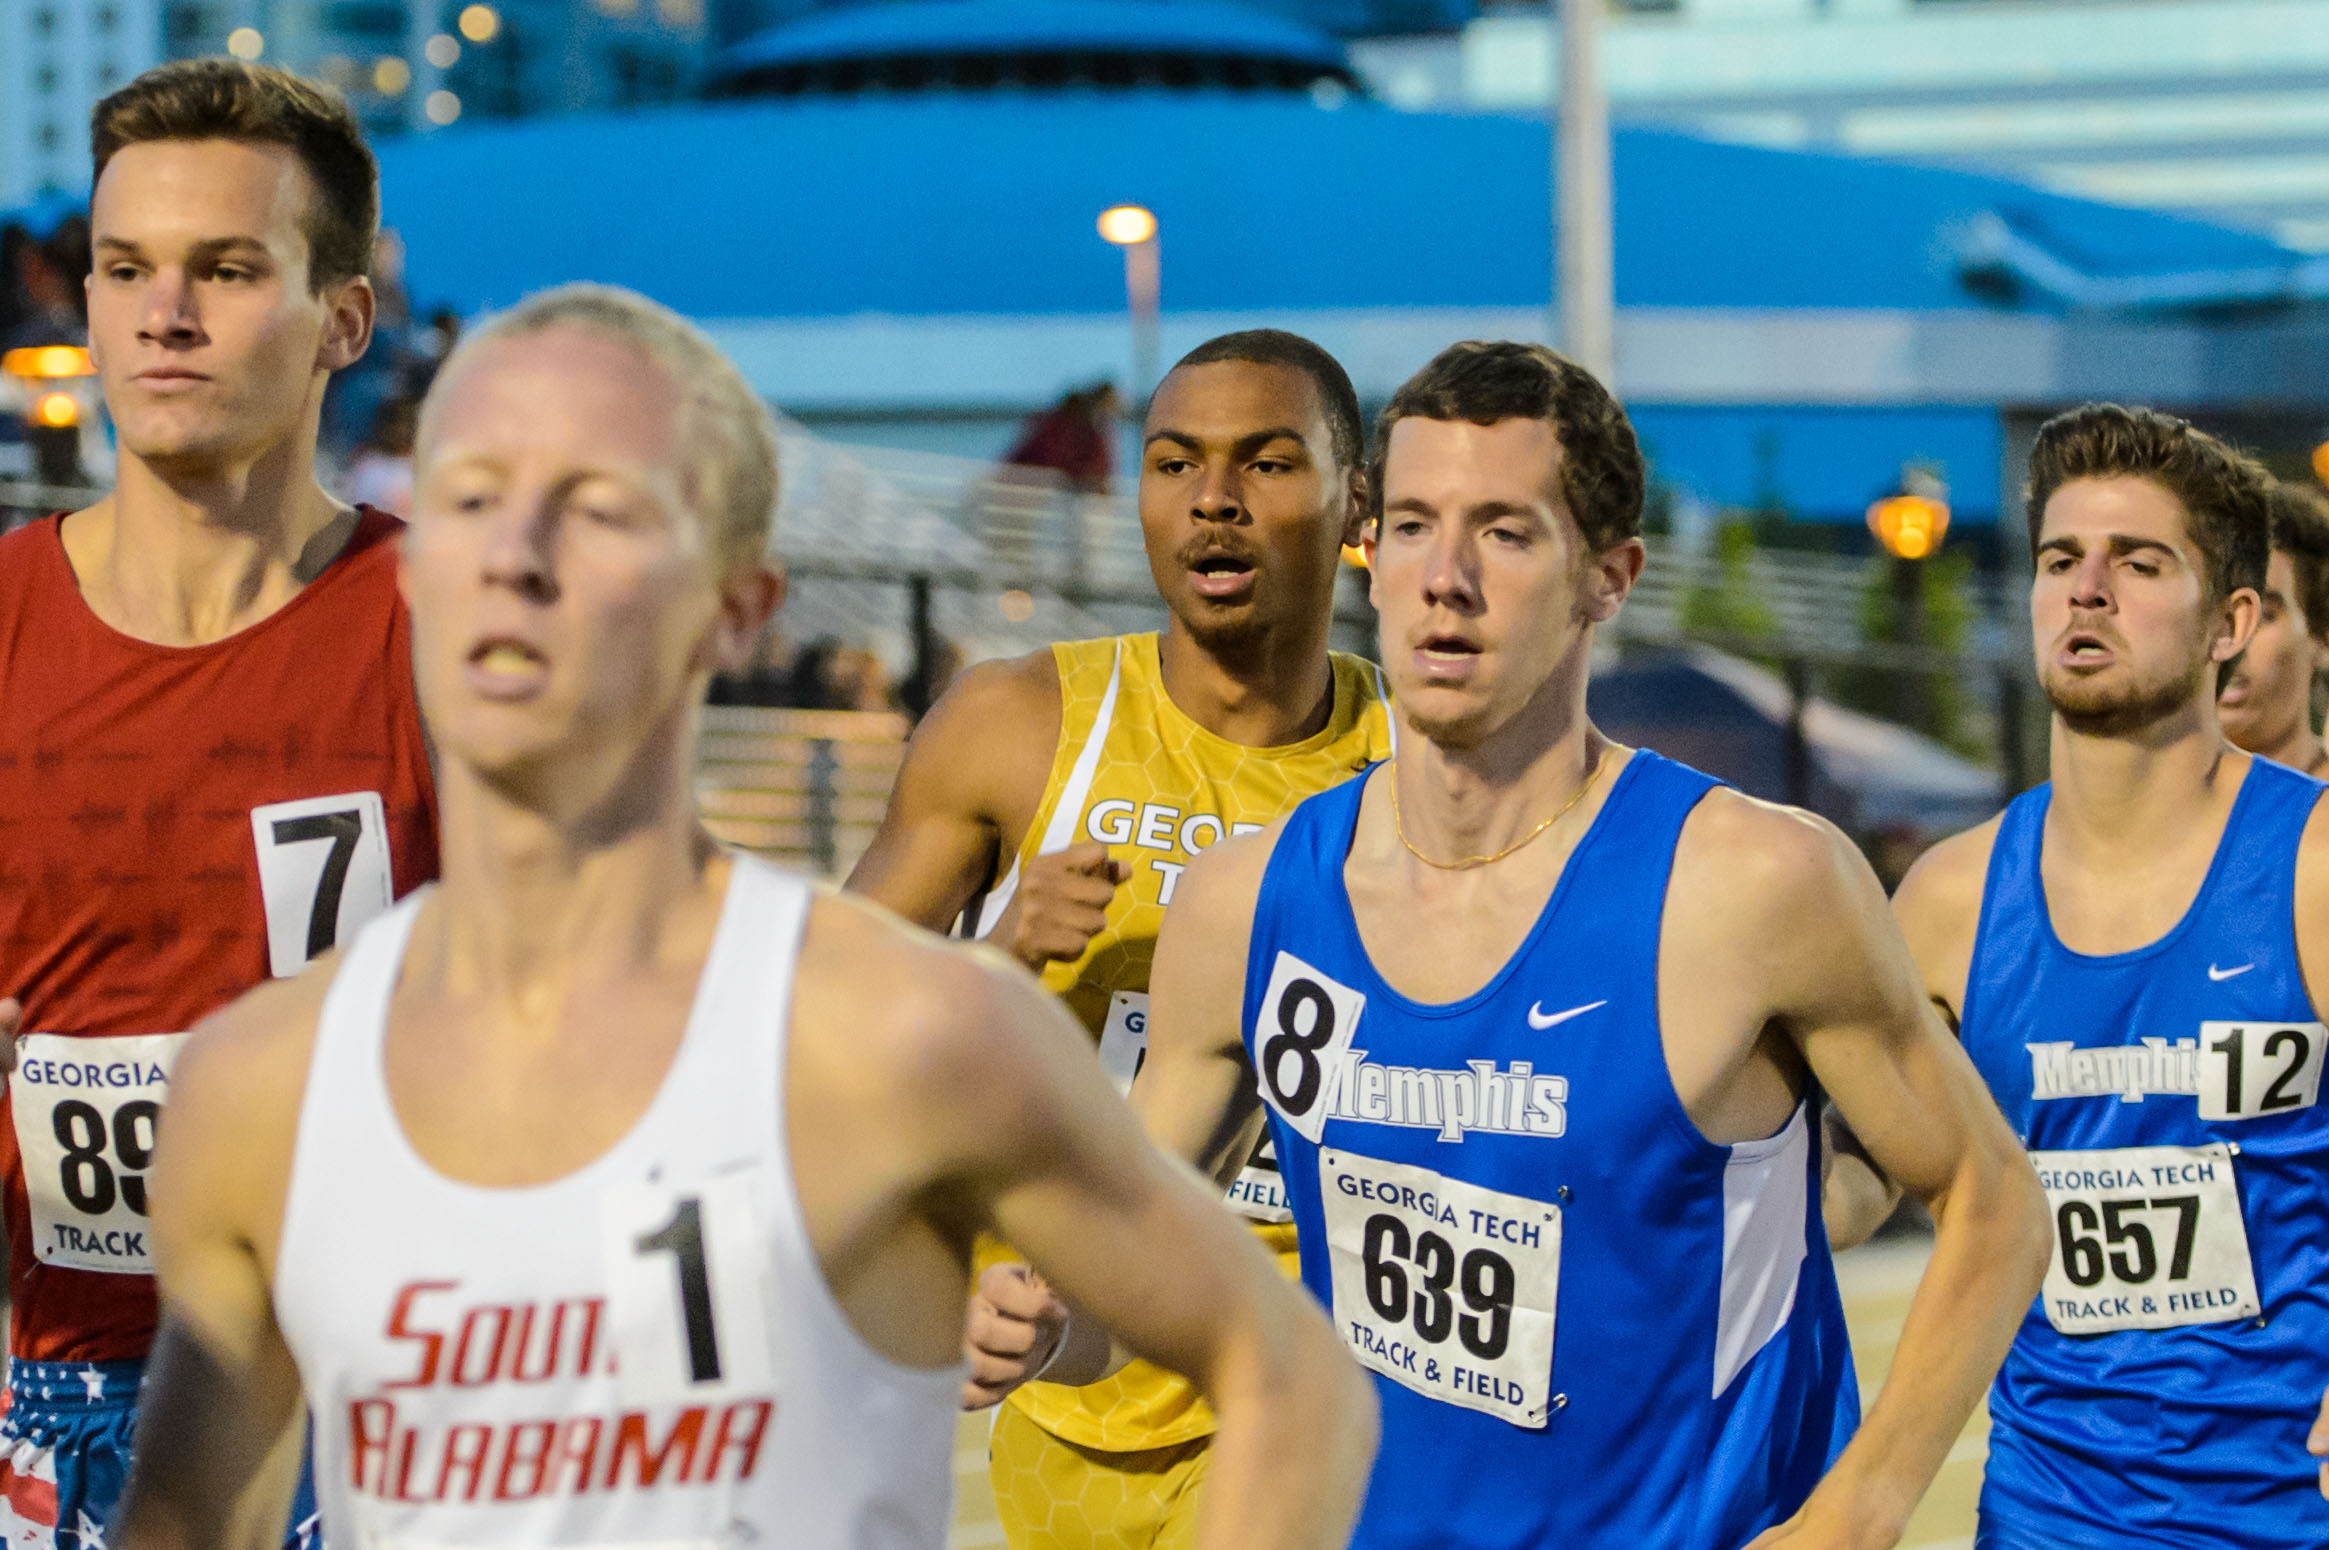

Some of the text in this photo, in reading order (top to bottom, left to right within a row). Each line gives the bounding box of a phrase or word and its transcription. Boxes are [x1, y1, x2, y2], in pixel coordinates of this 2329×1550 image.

[1086, 798, 1264, 856] GEO
[271, 809, 363, 962] 7
[23, 1058, 168, 1088] GEORGIA
[1263, 978, 1335, 1116] 8
[2025, 1037, 2201, 1103] Memphi
[2211, 1028, 2310, 1114] 12
[1337, 1174, 1541, 1248] GEORGIA TECH
[2039, 1163, 2215, 1190] GEORGIA TECH
[54, 1223, 147, 1256] TRACK
[2057, 1195, 2200, 1288] 657
[633, 1194, 721, 1384] 1
[1362, 1213, 1515, 1361] 639
[2056, 1288, 2237, 1319] TRACK & FIELD
[380, 1279, 618, 1388] SOUT
[1351, 1321, 1417, 1373] TRACK
[1425, 1358, 1441, 1383] &
[1454, 1367, 1524, 1406] FIELD
[349, 1396, 773, 1503] ALABAMA
